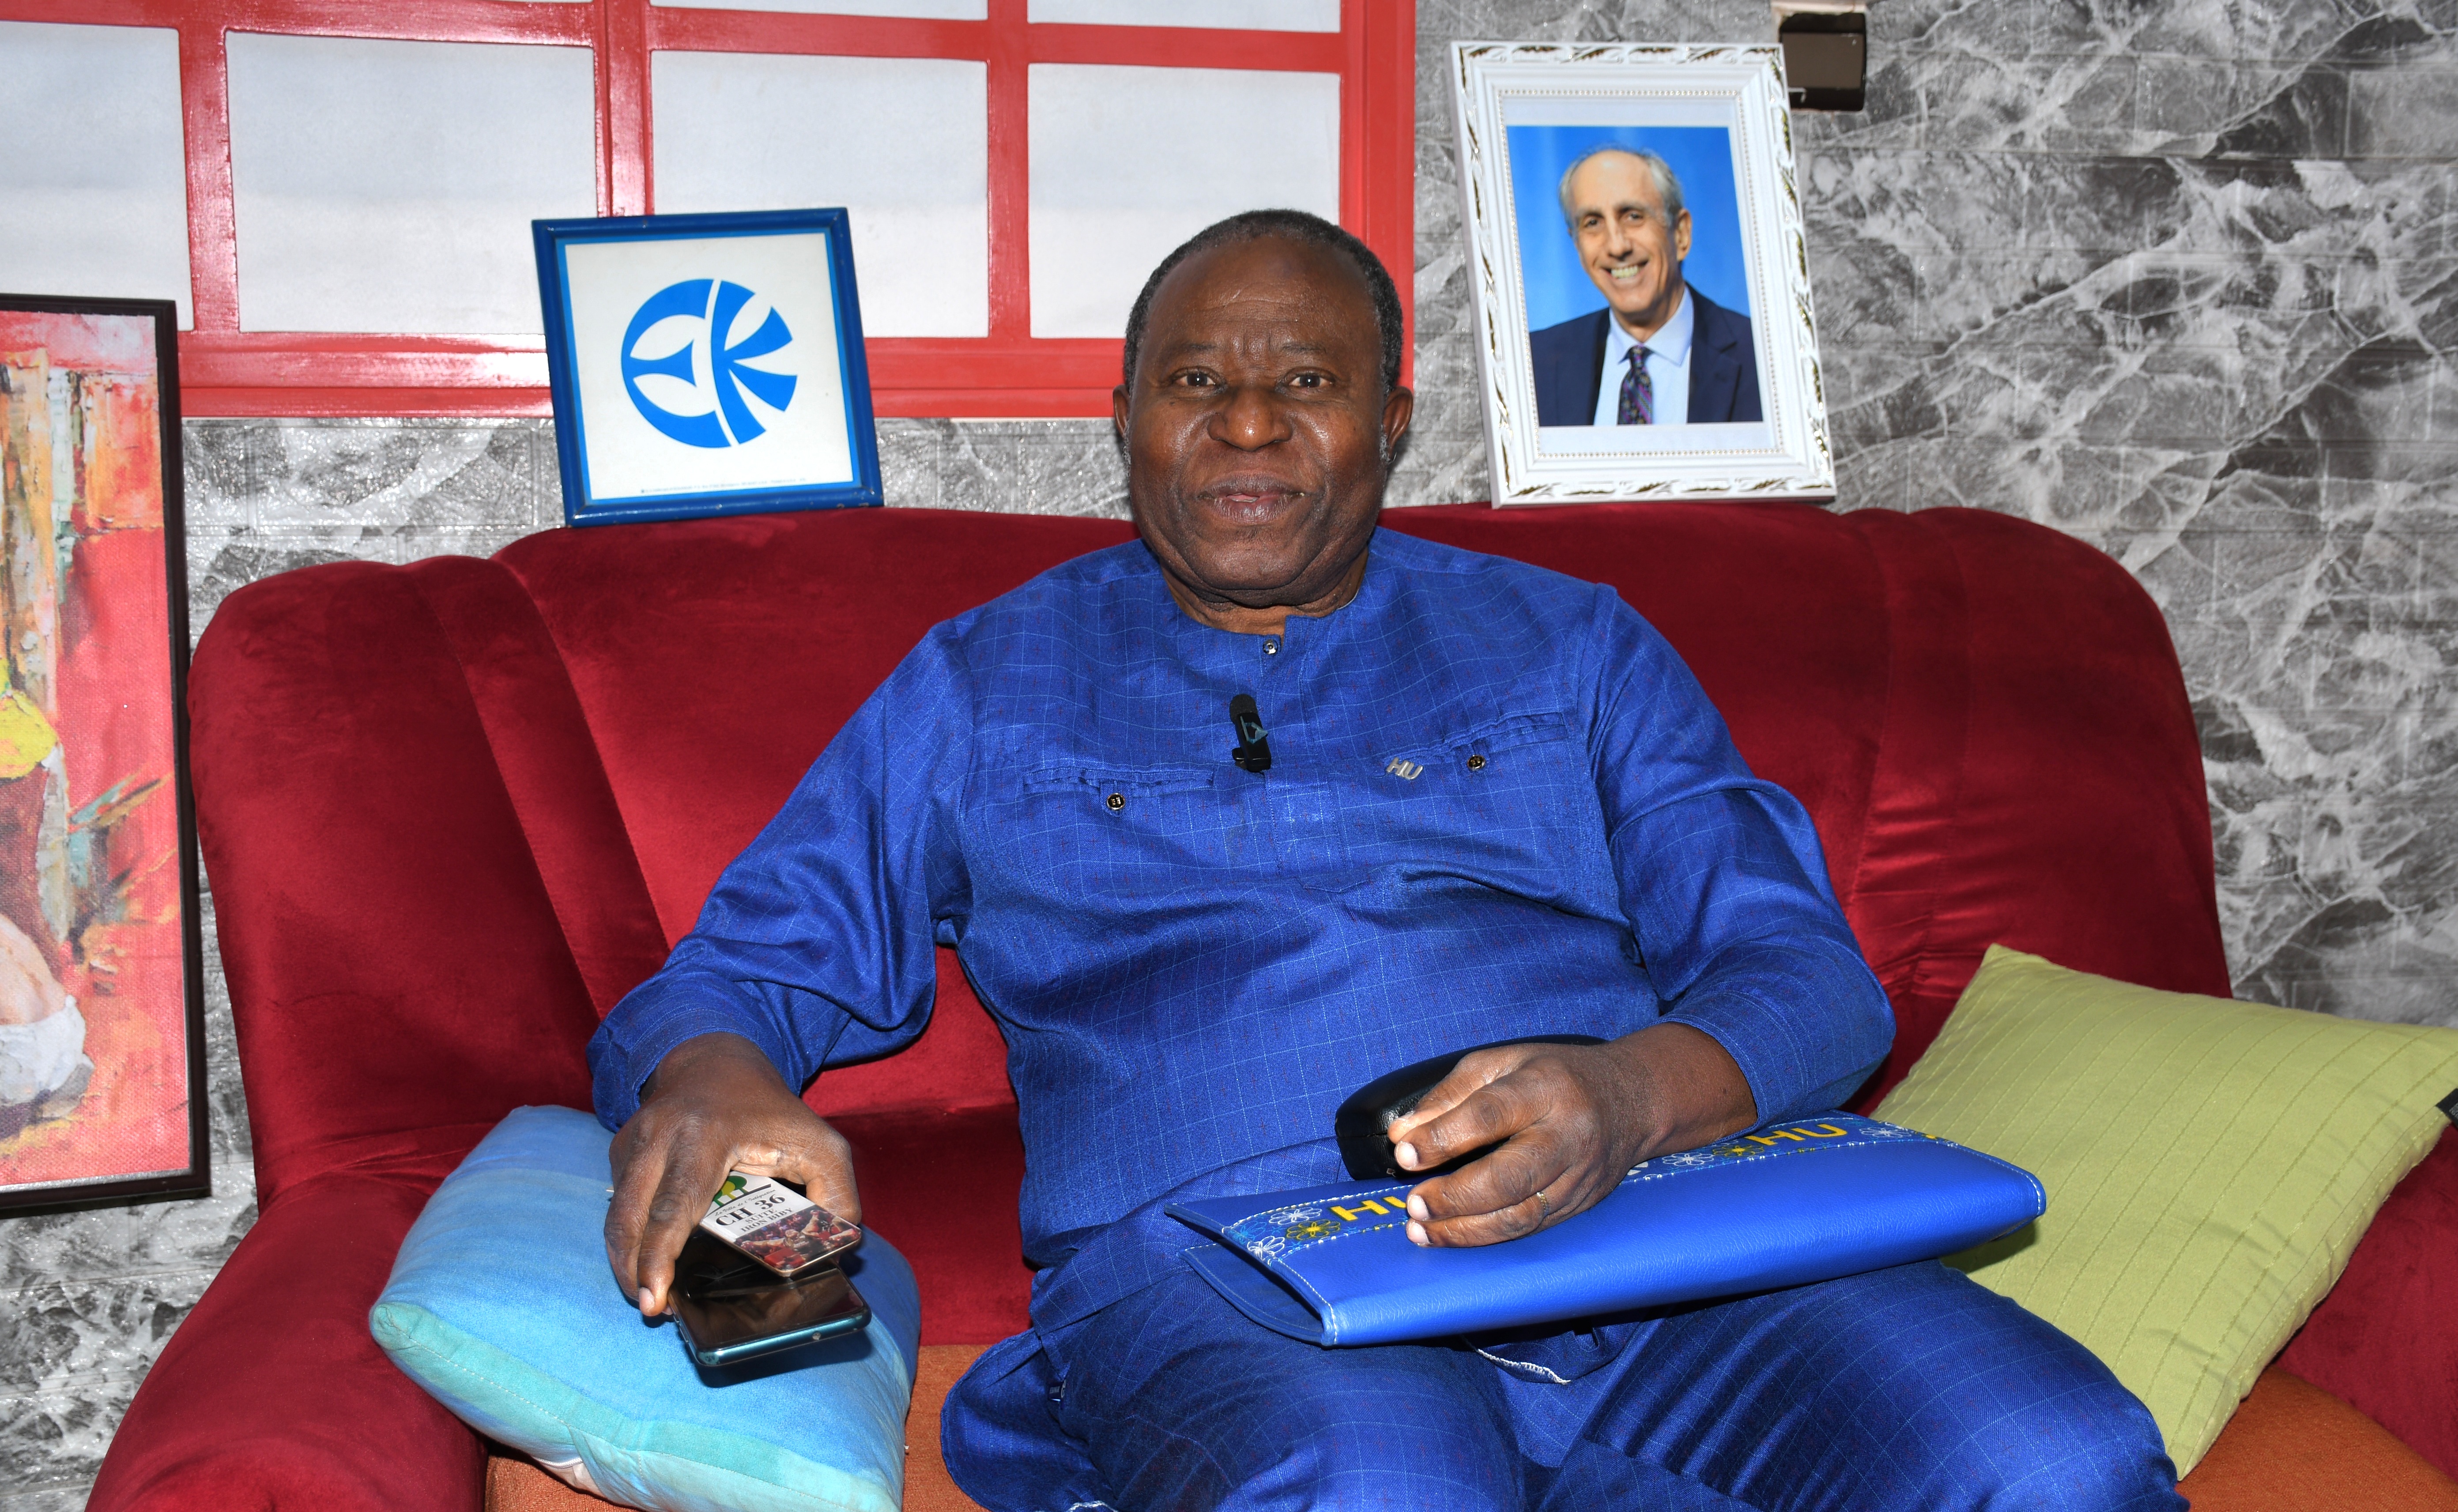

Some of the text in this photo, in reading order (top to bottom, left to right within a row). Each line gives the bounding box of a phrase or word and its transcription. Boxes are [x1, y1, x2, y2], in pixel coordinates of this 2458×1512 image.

[1386, 757, 1423, 780] HU
[1745, 1123, 1848, 1146] HU
[716, 1194, 785, 1226] CH 36
[740, 1207, 793, 1232] IRON BIBY
[745, 1208, 777, 1223] SUITE
